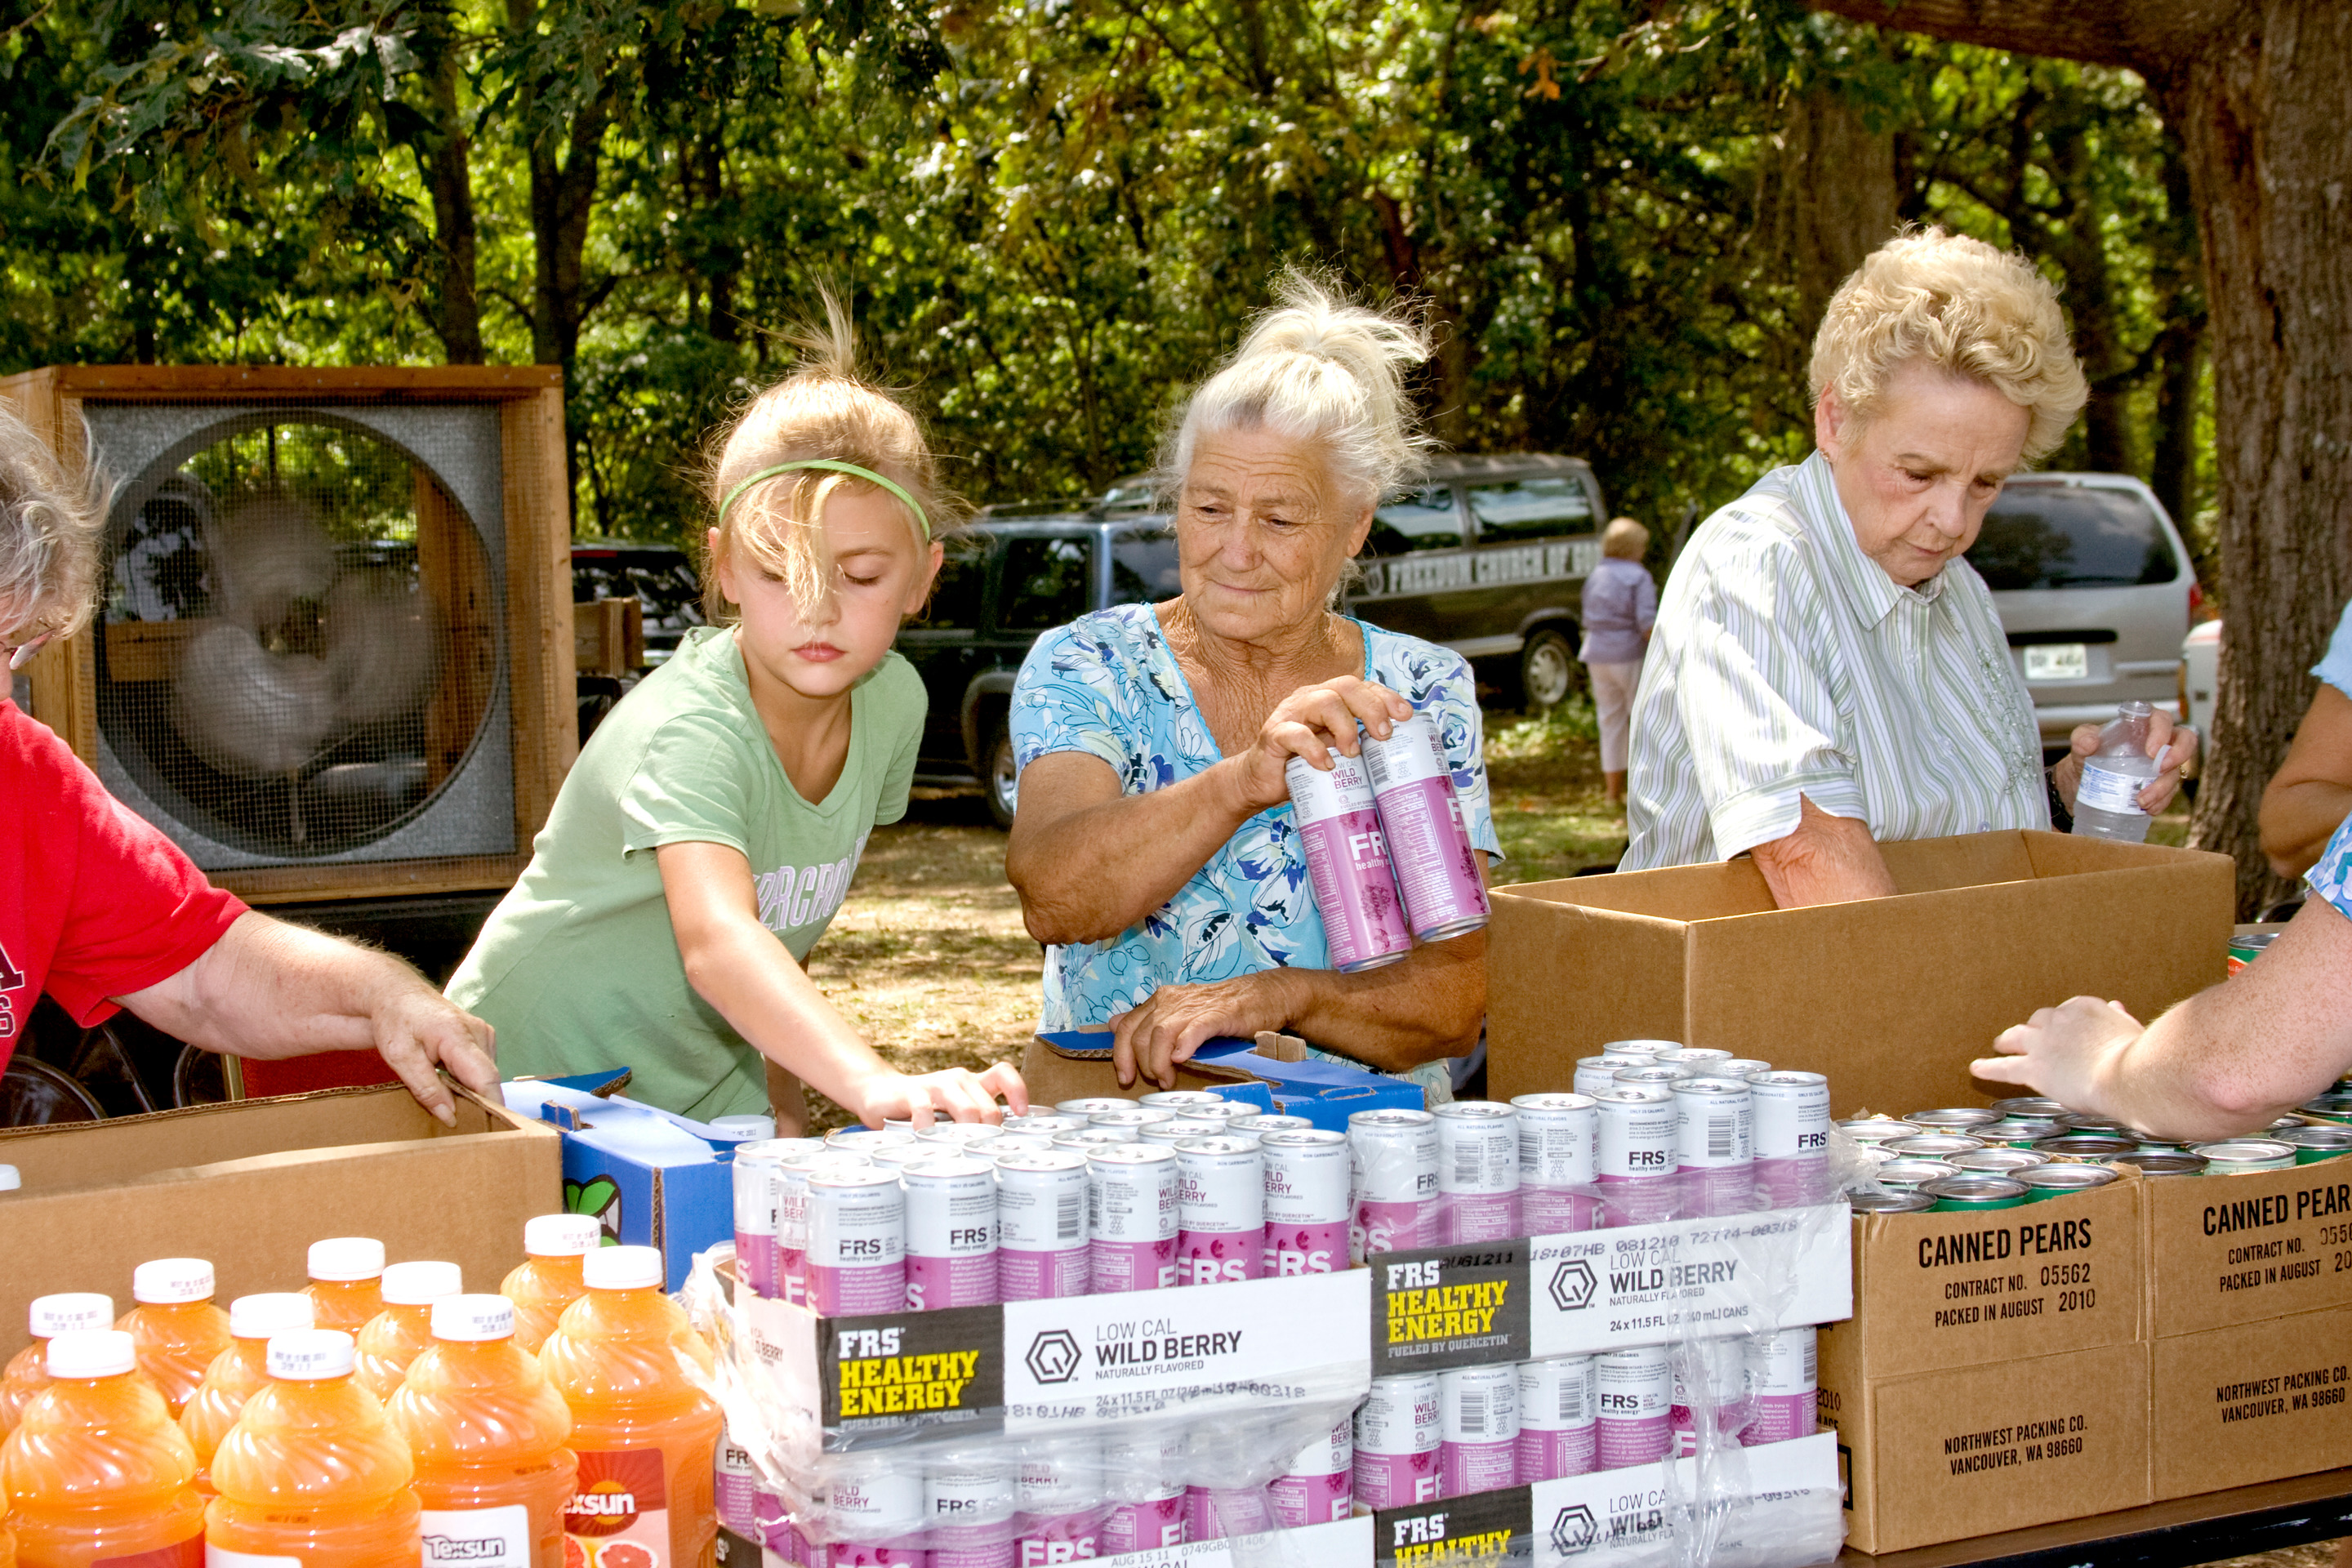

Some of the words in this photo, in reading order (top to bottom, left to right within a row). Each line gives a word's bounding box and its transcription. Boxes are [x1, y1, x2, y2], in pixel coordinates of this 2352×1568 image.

[1331, 768, 1356, 780] WILD
[1334, 776, 1363, 789] BERRY
[1348, 831, 1387, 861] FR
[1355, 858, 1384, 871] healthy
[1798, 1131, 1826, 1148] FRS
[1628, 1150, 1665, 1165] FRS
[1178, 1190, 1206, 1203] ERRY
[1266, 1182, 1292, 1195] ERRY
[2203, 1194, 2289, 1236] CANNED
[2296, 1183, 2352, 1220] PEAR
[839, 1238, 882, 1256] FRS
[950, 1227, 987, 1245] FRS
[950, 1244, 971, 1252] healthy
[972, 1242, 988, 1250] energy
[1918, 1229, 2011, 1268] CANNED
[2020, 1218, 2091, 1256] PEARS
[839, 1254, 862, 1263] healthy
[863, 1254, 883, 1262] energy
[1610, 1252, 1645, 1271] LOW
[2228, 1240, 2283, 1265] CONTRACT
[2286, 1237, 2305, 1255] NO.
[1388, 1260, 1440, 1290] FRS
[1609, 1268, 1663, 1294] WILD
[1669, 1258, 1739, 1287] BERRY
[1944, 1276, 2004, 1300] CONTRACT
[2008, 1274, 2028, 1291] NO.
[2041, 1263, 2091, 1286] 05562
[2219, 1270, 2261, 1293] PACKED
[2265, 1267, 2277, 1285] IN
[2280, 1259, 2322, 1282] AUGUST
[2334, 1250, 2352, 1272] 20
[1388, 1280, 1508, 1318] HEALTHY
[1609, 1292, 1659, 1307] NATURALLY
[1935, 1306, 1980, 1328] PACKED
[1984, 1304, 1996, 1321] IN
[2000, 1298, 2044, 1320] AUGUST
[2058, 1288, 2096, 1312] 2010
[1096, 1321, 1136, 1342] LOW
[1142, 1318, 1177, 1338] CAL
[1388, 1307, 1496, 1344] ENERGY
[1610, 1320, 1622, 1332] 24
[1624, 1322, 1630, 1330] x
[1632, 1316, 1651, 1330] 11.5
[1653, 1316, 1666, 1327] FL
[1722, 1305, 1748, 1318] CANS
[838, 1327, 901, 1360] FRS
[1095, 1339, 1157, 1366] WILD
[1164, 1330, 1242, 1359] BERRY
[1388, 1342, 1431, 1359] FUELED
[1432, 1340, 1446, 1352] BY
[1448, 1334, 1509, 1352] QUERCETIN
[839, 1349, 979, 1389] HEALTHY
[1095, 1364, 1152, 1380] NATURALLY
[1154, 1359, 1205, 1374] FLAVORED
[2216, 1377, 2281, 1403] NORTHWEST
[2283, 1368, 2329, 1391] PACKING
[2332, 1365, 2350, 1383] CO.
[840, 1379, 964, 1417] ENERGY
[1095, 1395, 1111, 1407] 24
[1120, 1392, 1143, 1405] 11.5
[1145, 1390, 1160, 1402] FL
[1414, 1400, 1437, 1414] WILD
[1601, 1392, 1639, 1410] FRS
[1601, 1407, 1619, 1415] healthy
[2221, 1397, 2288, 1423] VANCOUVER,
[2292, 1393, 2309, 1411] WA
[2311, 1387, 2346, 1408] 98660
[1944, 1428, 2013, 1455] NORTHWEST
[2016, 1418, 2065, 1442] PACKING
[2069, 1414, 2088, 1432] CO.
[1950, 1449, 2022, 1476] VANCOUVER,
[2025, 1444, 2043, 1462] WA
[2047, 1437, 2082, 1459] 98660
[833, 1494, 869, 1508] BERRY
[936, 1498, 978, 1514] FRS
[1609, 1491, 1643, 1514] LOW
[1648, 1488, 1667, 1507] CA
[1393, 1512, 1445, 1548] FRS
[421, 1535, 506, 1561] Texsun
[1111, 1553, 1135, 1567] AUG
[1140, 1552, 1152, 1563] 15
[1157, 1550, 1169, 1561] 11
[1394, 1528, 1512, 1568] HEALTHY
